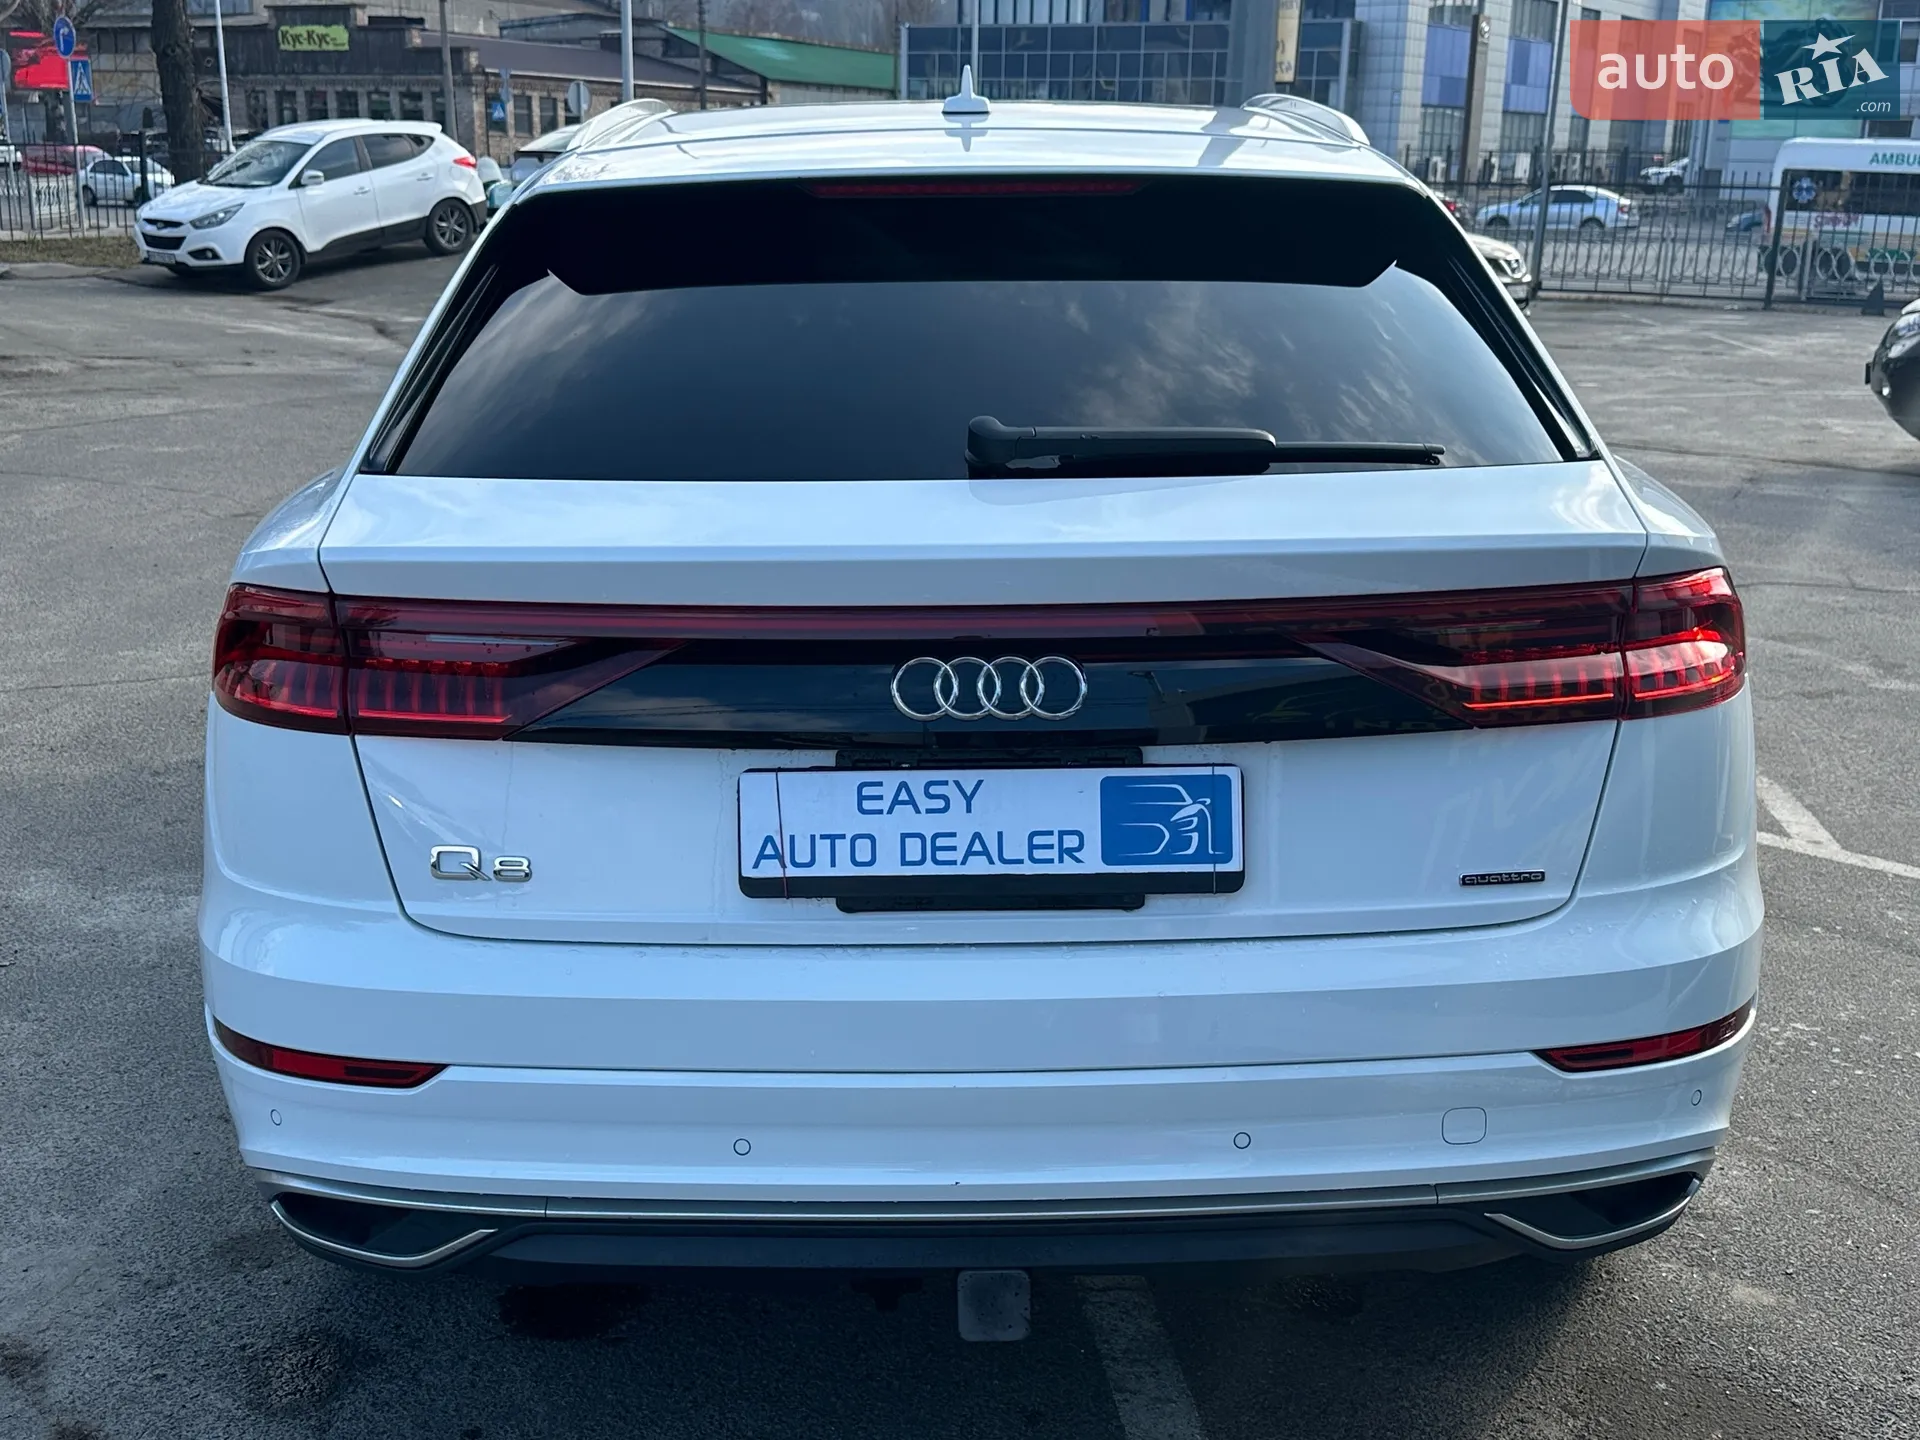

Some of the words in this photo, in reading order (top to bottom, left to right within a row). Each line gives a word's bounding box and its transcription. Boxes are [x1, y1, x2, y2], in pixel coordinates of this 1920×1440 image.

[856, 779, 984, 816] EASY
[430, 844, 533, 882] Q8
[752, 832, 878, 870] AUTO
[900, 829, 1085, 867] DEALER
[1464, 872, 1542, 885] quattro
